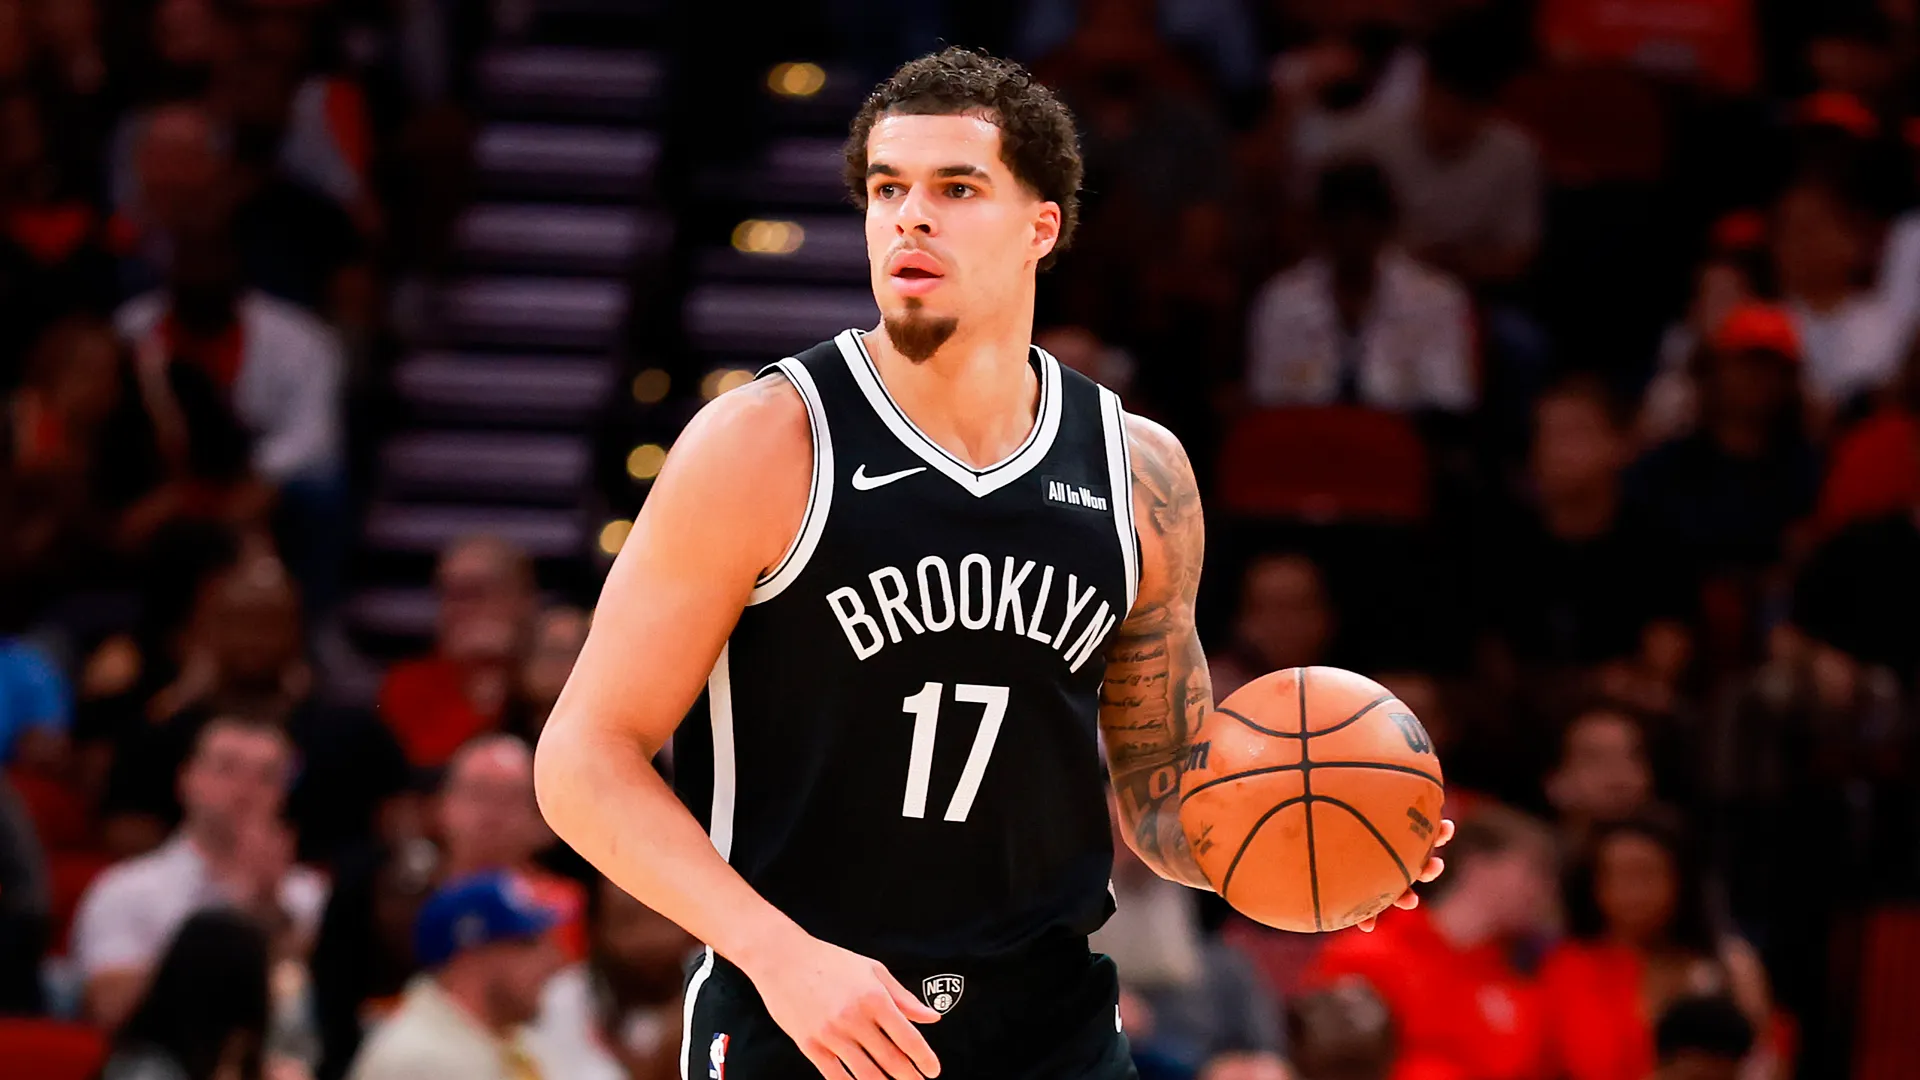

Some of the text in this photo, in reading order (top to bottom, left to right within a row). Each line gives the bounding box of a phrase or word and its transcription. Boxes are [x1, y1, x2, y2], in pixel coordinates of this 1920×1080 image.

[1049, 481, 1107, 510] All In Won
[826, 553, 1116, 674] BROOKLYN
[902, 682, 1010, 822] 17
[927, 978, 960, 996] NETS
